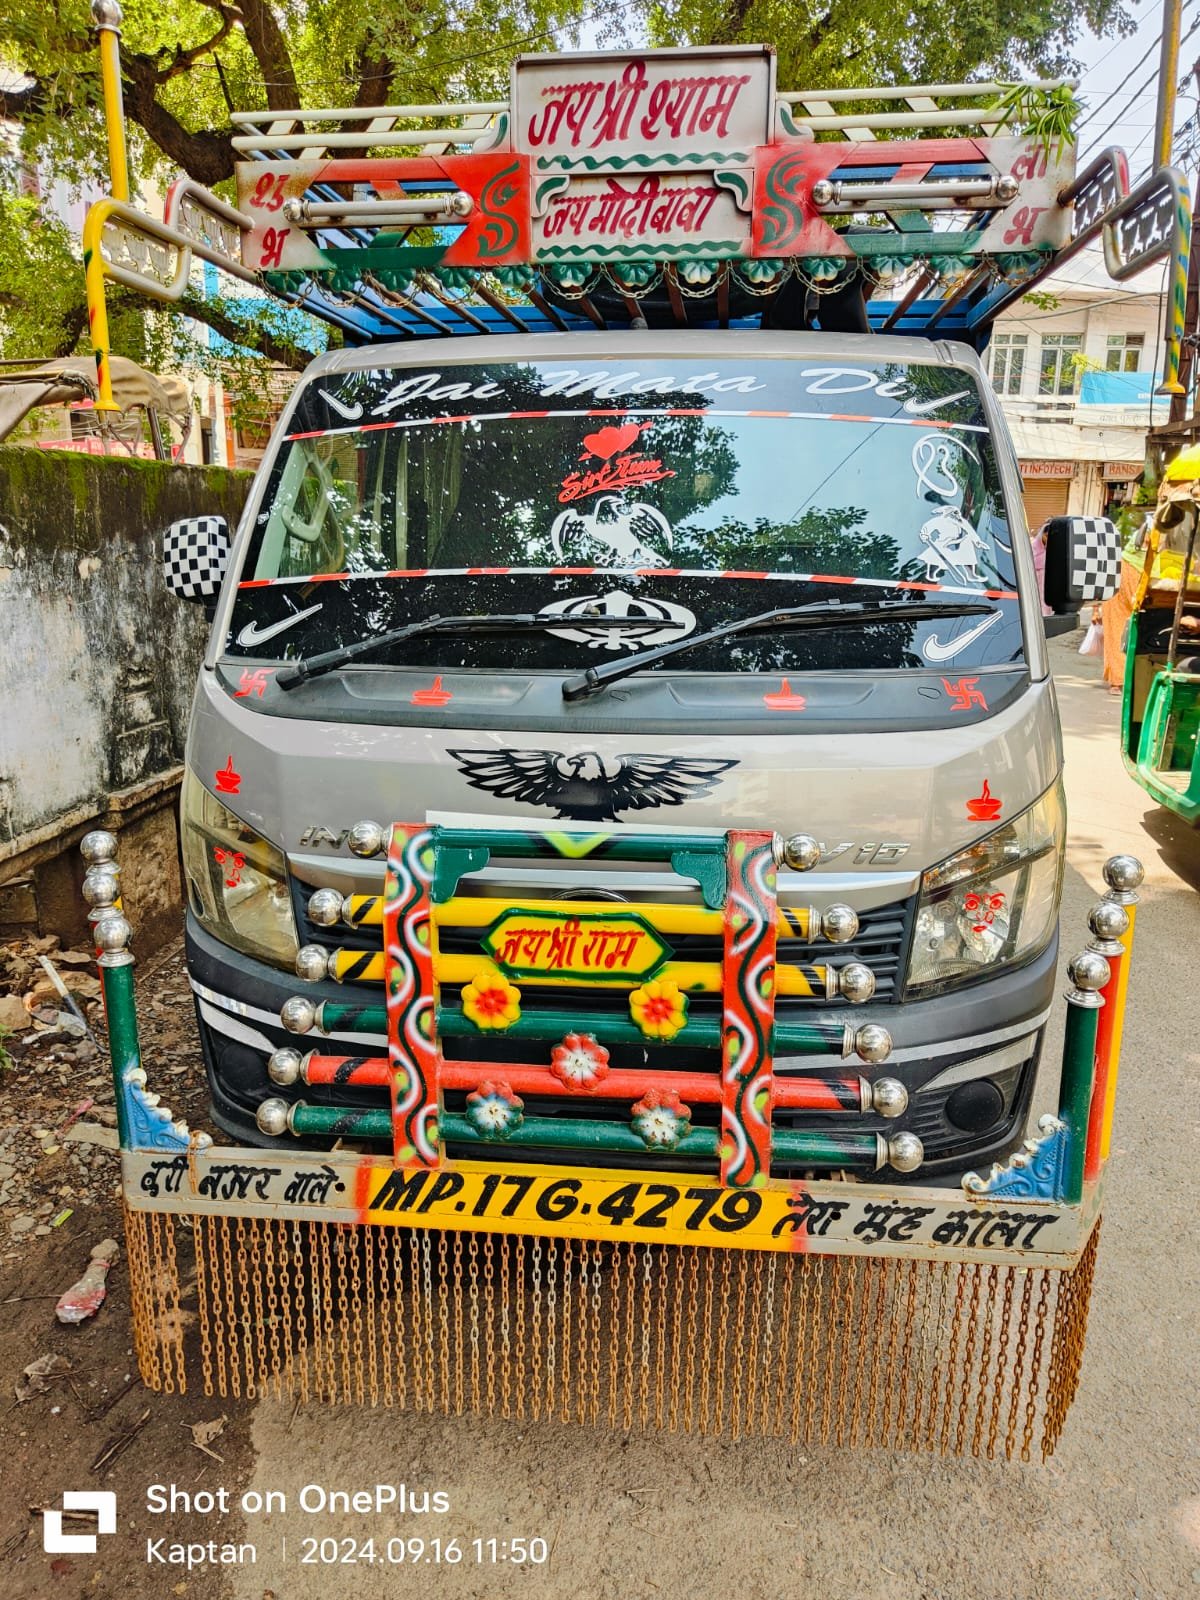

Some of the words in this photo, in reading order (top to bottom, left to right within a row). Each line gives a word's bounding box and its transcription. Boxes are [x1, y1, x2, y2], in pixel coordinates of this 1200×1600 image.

[528, 81, 605, 147] जय
[587, 59, 649, 149] श्री
[640, 75, 751, 140] श्याम
[543, 195, 597, 238] जय
[588, 175, 660, 238] मोदी
[539, 369, 767, 399] Mata
[800, 367, 907, 397] Di
[1030, 463, 1072, 475] INFOTECH
[494, 928, 551, 965] जय
[546, 915, 583, 972] श्री
[583, 929, 645, 968] राम
[284, 1164, 340, 1204] वाले
[771, 1190, 850, 1238] तेरा
[932, 1208, 1060, 1250] काला
